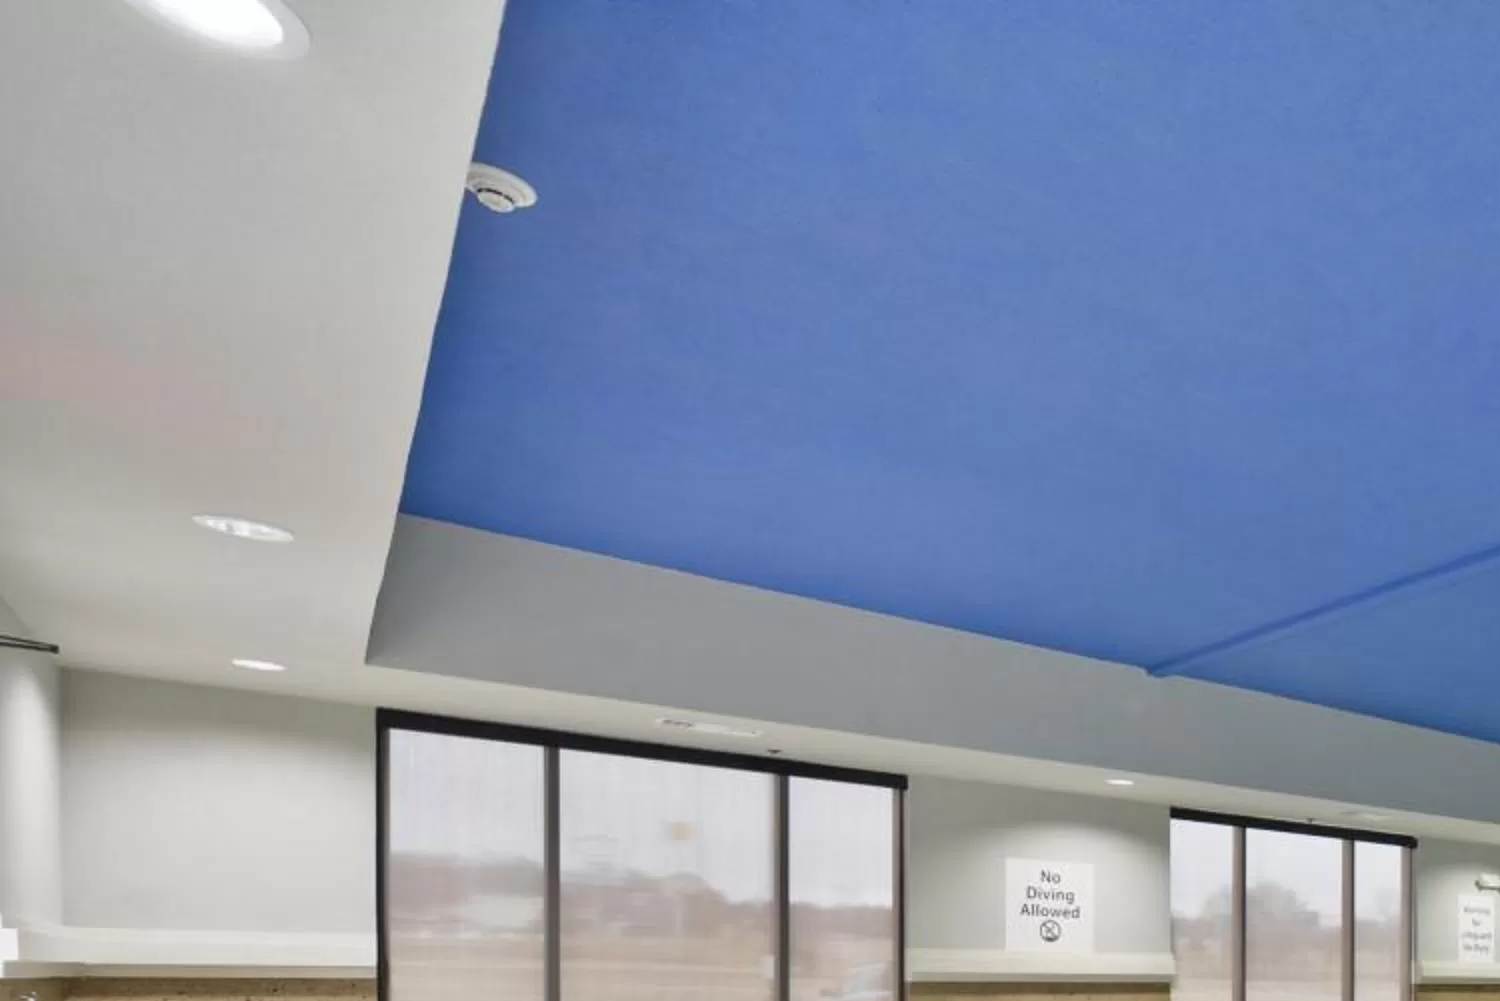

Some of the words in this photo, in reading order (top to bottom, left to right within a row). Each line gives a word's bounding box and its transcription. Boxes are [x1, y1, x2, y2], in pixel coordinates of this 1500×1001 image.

[1040, 869, 1061, 884] No
[1026, 885, 1076, 905] Diving
[1020, 903, 1081, 919] Allowed
